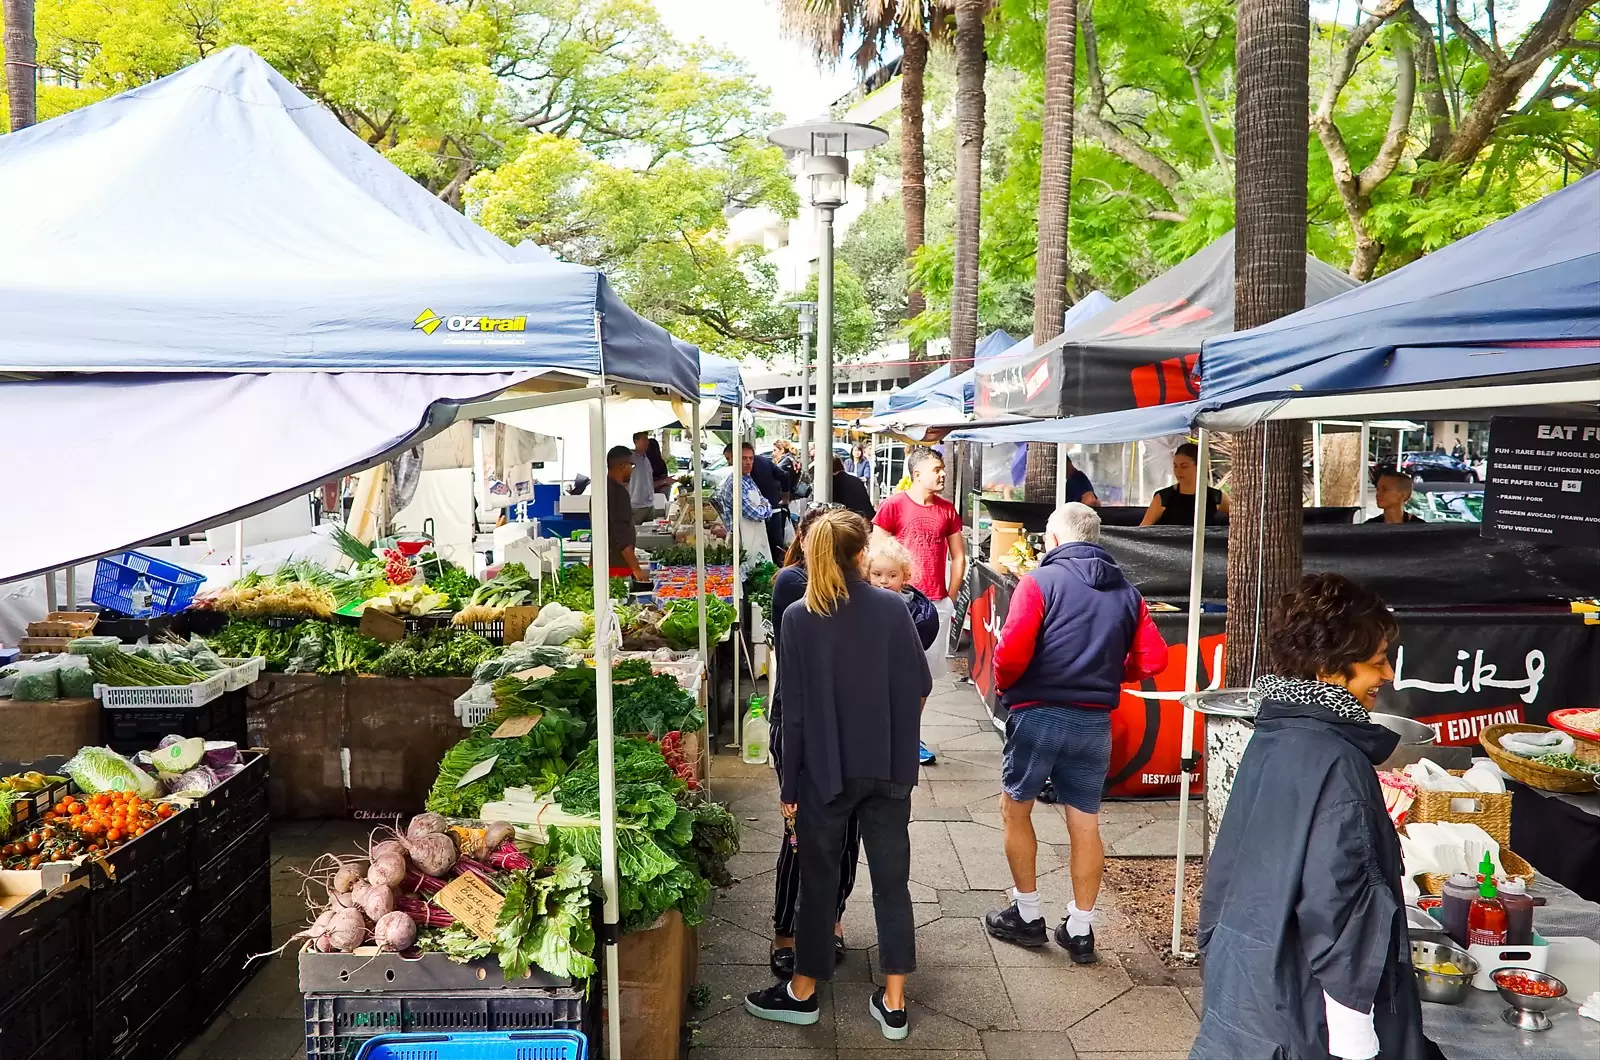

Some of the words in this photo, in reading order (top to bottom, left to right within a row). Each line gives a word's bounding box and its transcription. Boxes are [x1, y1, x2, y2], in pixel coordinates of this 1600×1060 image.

[1537, 425, 1578, 440] EAT
[1514, 525, 1553, 534] VEGETARIAN
[1427, 721, 1443, 743] T
[1447, 709, 1519, 741] EDITION
[1141, 772, 1201, 785] RESTAURNT
